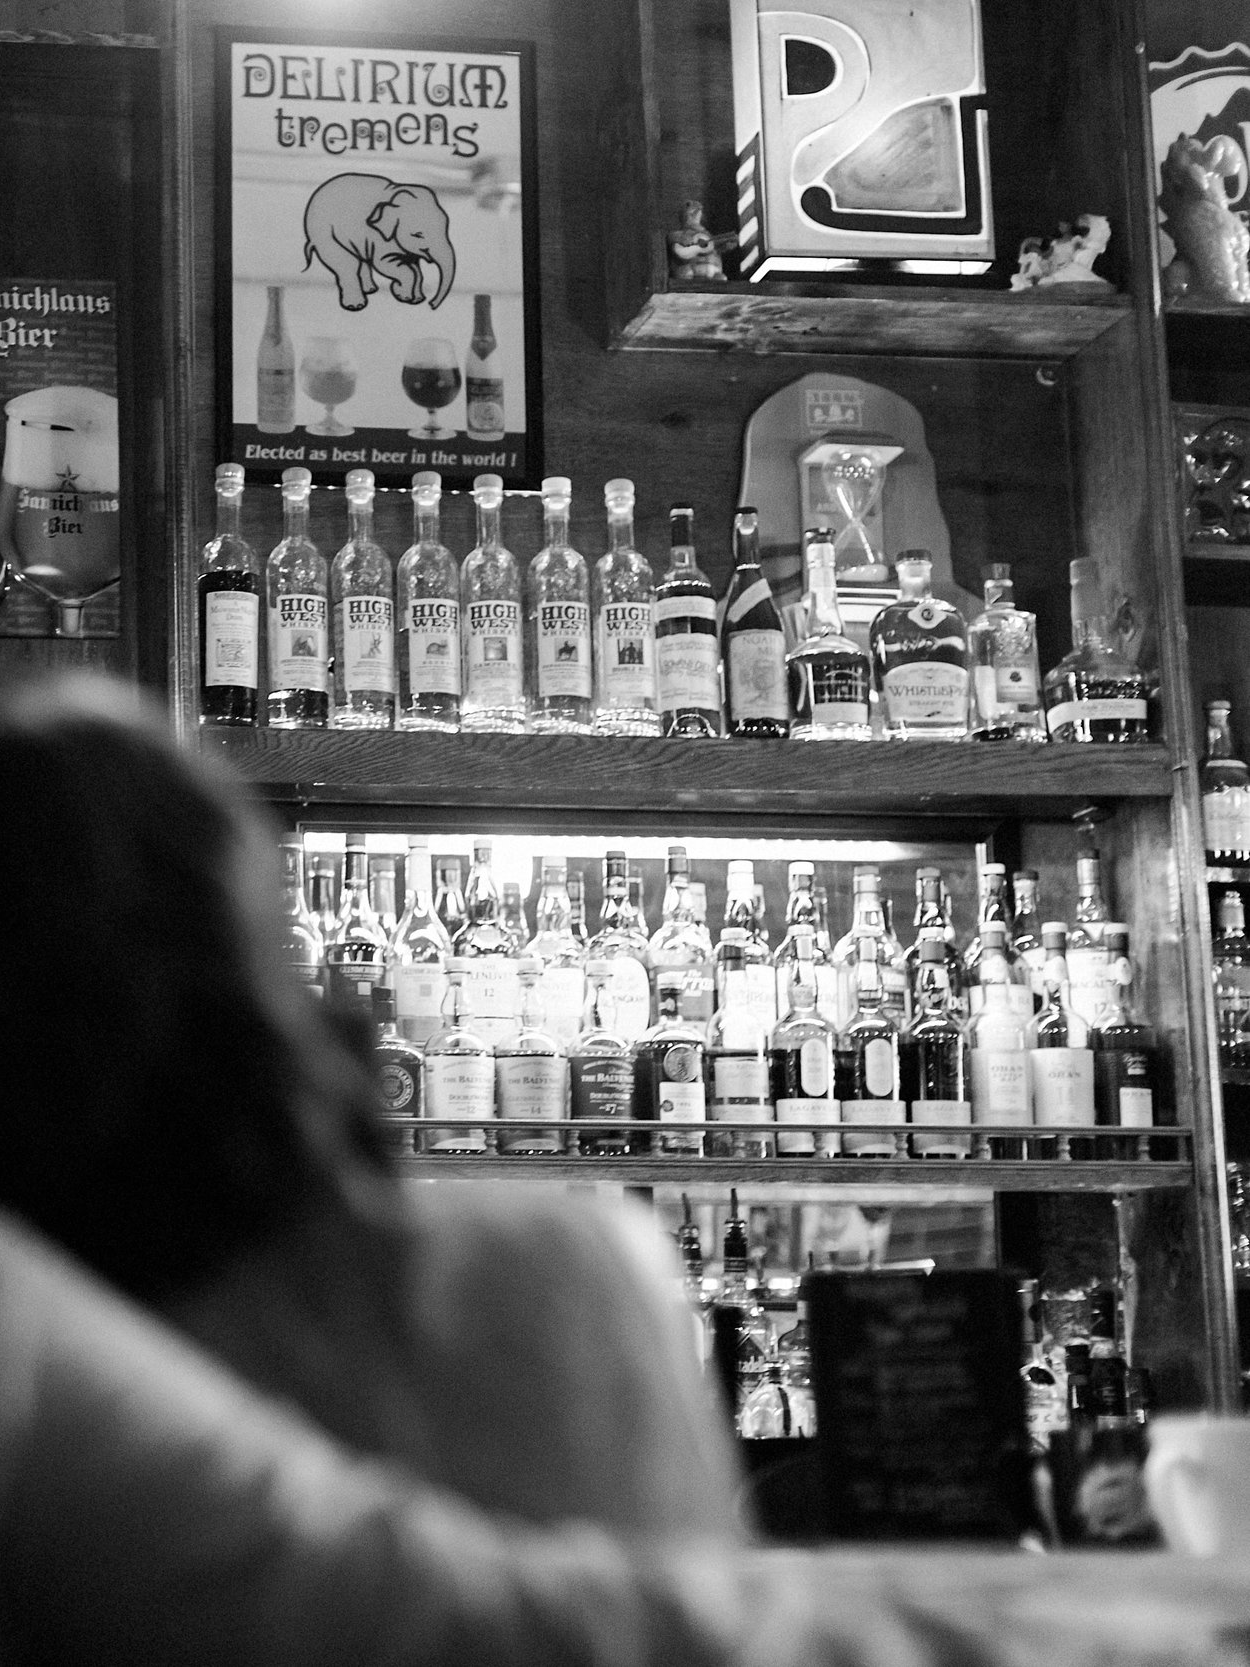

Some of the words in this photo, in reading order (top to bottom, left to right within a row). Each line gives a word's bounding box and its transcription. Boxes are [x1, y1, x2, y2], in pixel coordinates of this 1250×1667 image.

[241, 53, 509, 110] DELIRIUM
[274, 108, 480, 158] tremens
[245, 444, 305, 461] Elected
[308, 449, 327, 461] as
[332, 447, 366, 462] best
[371, 448, 408, 464] beer
[411, 449, 426, 465] in
[431, 449, 457, 465] the
[461, 452, 506, 467] world
[280, 598, 326, 614] HIGH
[350, 600, 392, 616] HIGH
[412, 603, 458, 620] HIGH
[471, 603, 517, 620] HIGH
[541, 605, 588, 621] HIGH
